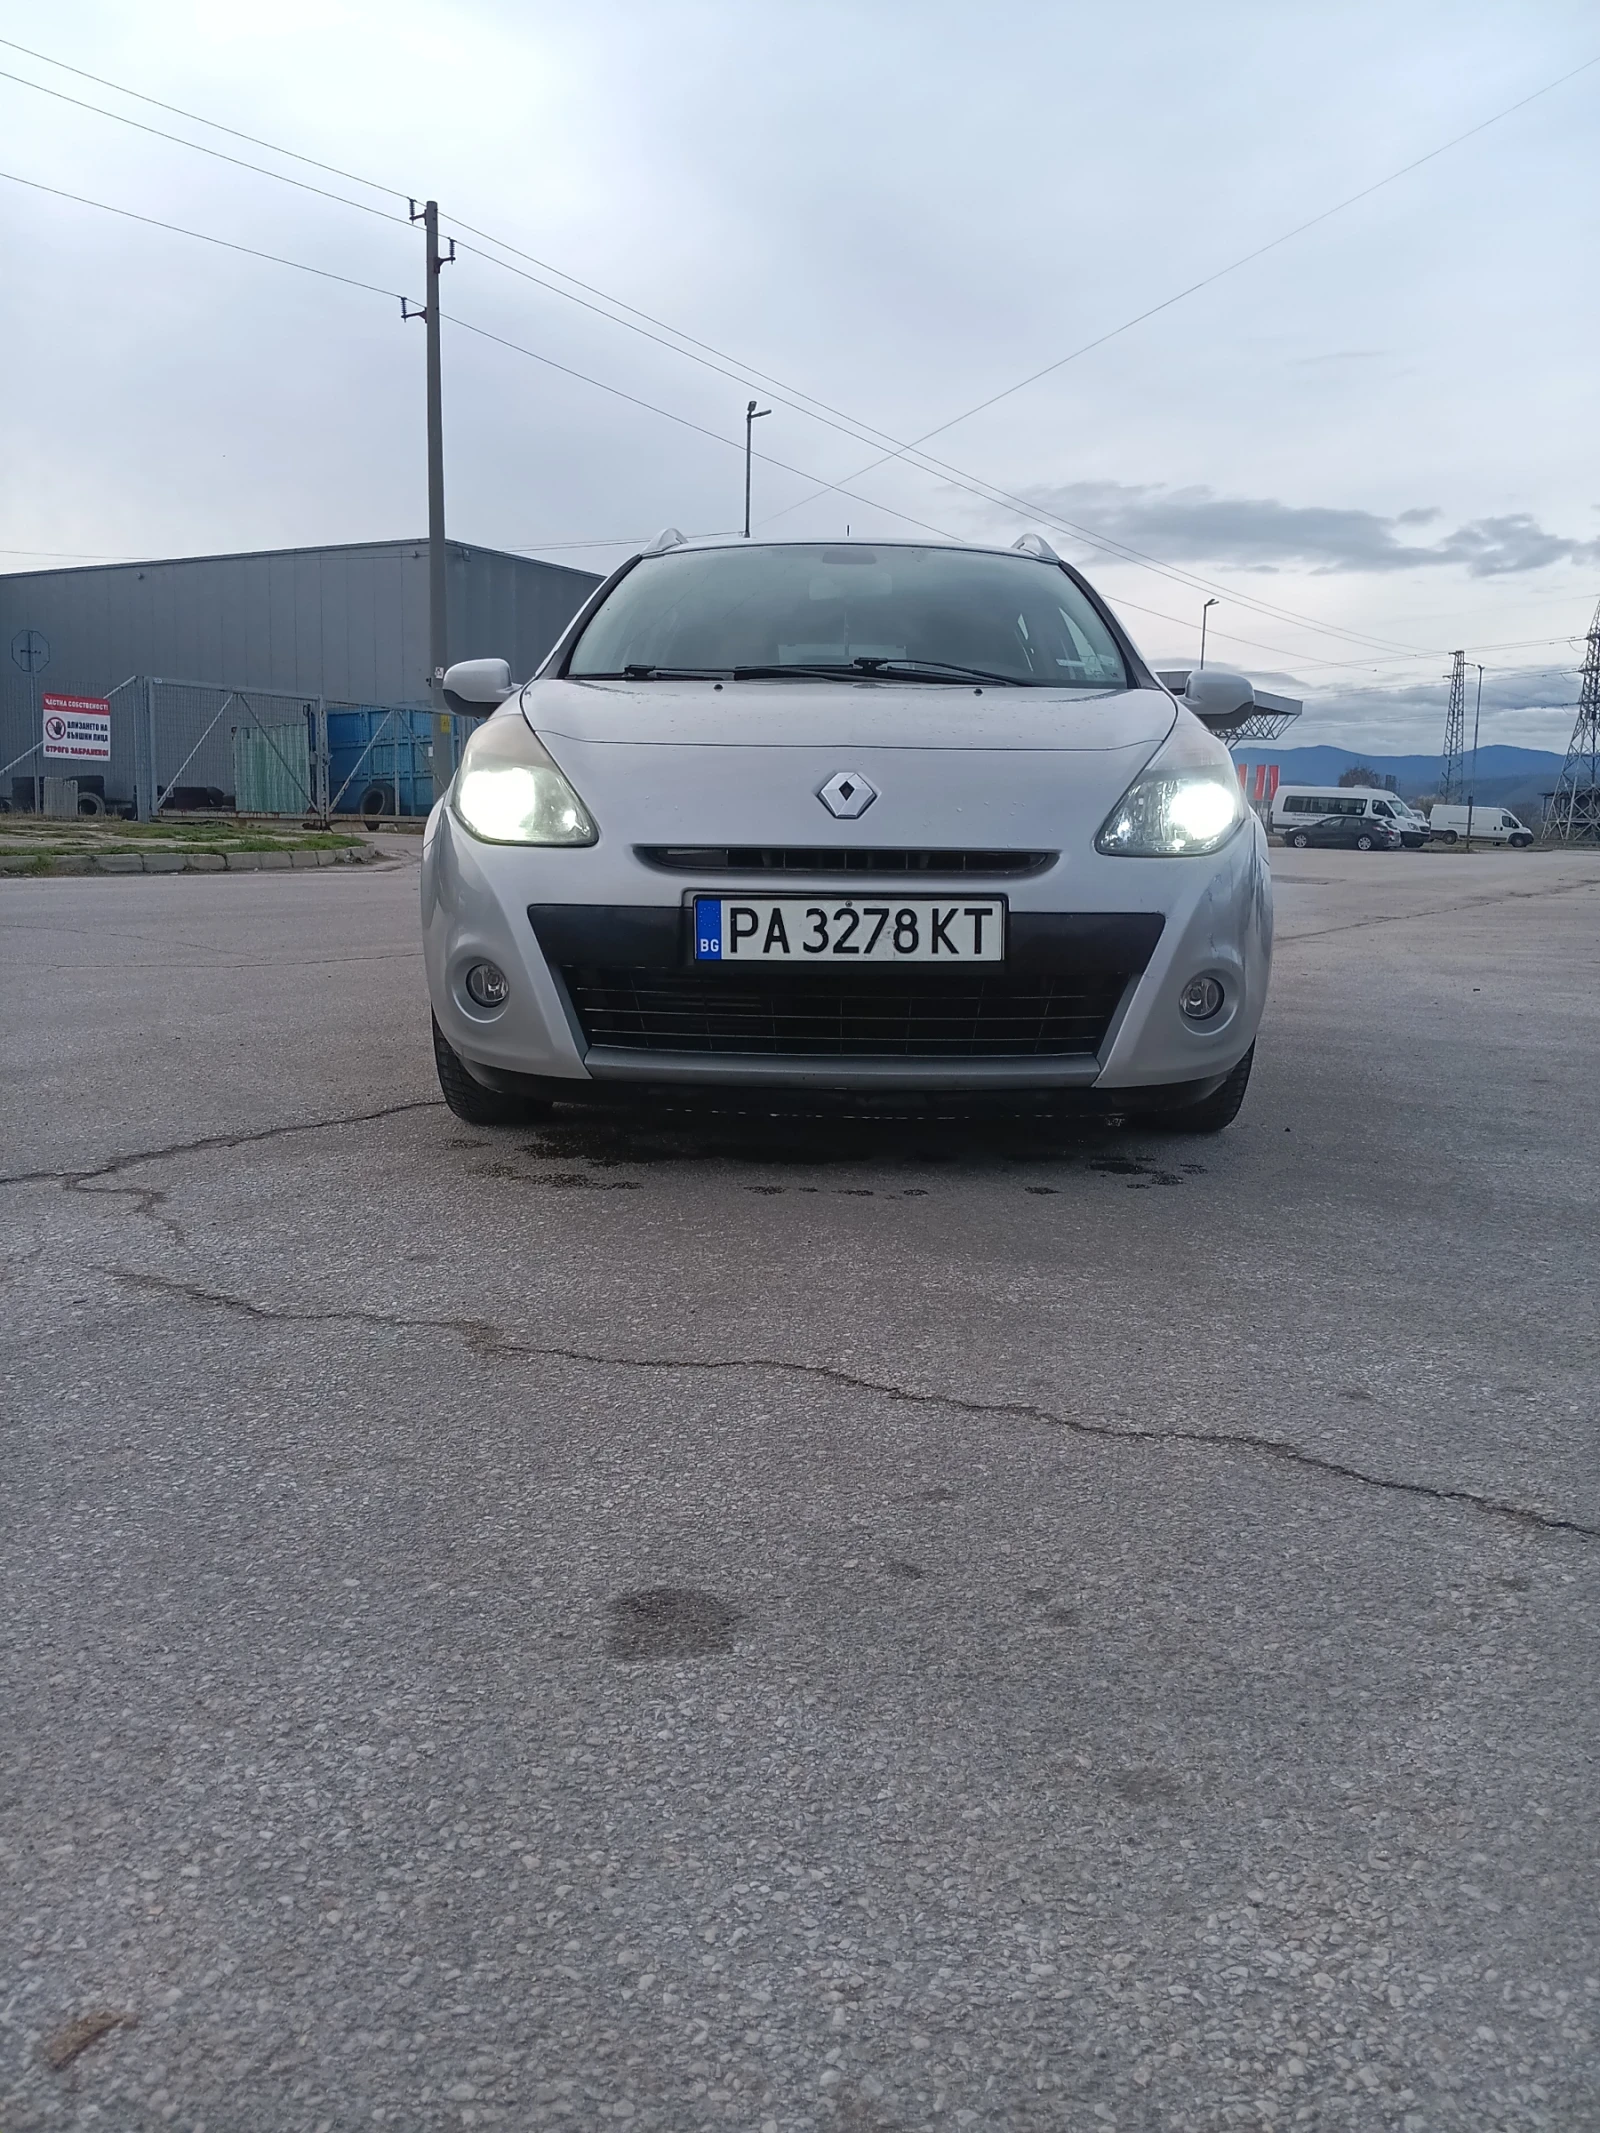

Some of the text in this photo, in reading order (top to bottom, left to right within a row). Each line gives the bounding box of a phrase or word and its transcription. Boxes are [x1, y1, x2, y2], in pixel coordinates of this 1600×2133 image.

[45, 745, 69, 753] СТРОГО
[700, 908, 993, 955] BG PA 3278 KT
